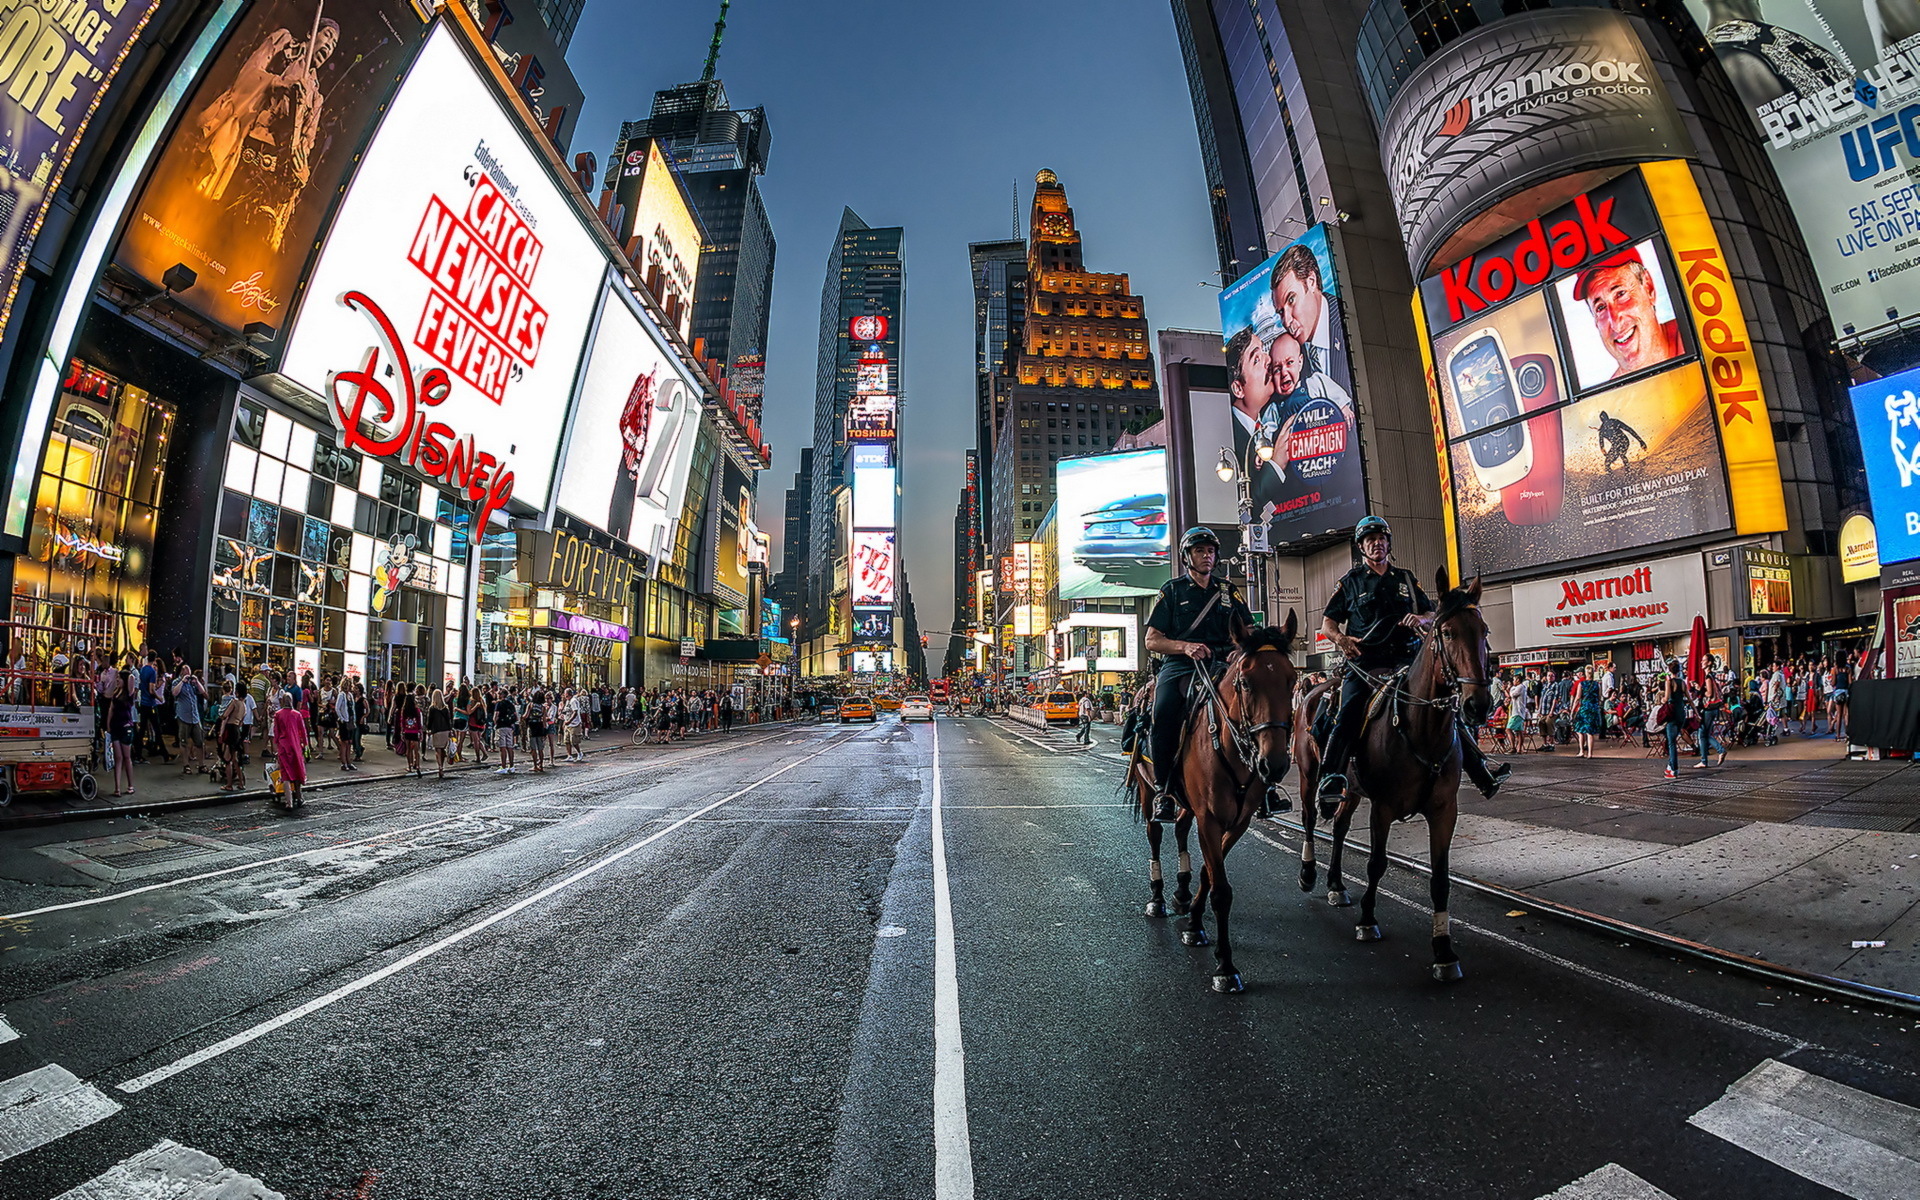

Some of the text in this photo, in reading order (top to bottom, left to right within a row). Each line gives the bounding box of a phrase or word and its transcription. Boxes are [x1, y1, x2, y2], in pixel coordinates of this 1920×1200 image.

[1814, 13, 1835, 40] LIGHT
[1832, 40, 1857, 75] WORLD
[1506, 83, 1652, 118] driving emotion
[1756, 91, 1797, 117] JON JONES
[1856, 85, 1876, 102] VS
[1760, 79, 1863, 150] BONES
[1845, 113, 1868, 128] CHAMPION
[474, 138, 519, 198] Entertainment
[624, 167, 641, 177] LG
[1849, 200, 1884, 229] SAT.
[142, 212, 227, 275] www.georgekalinsky.com
[1836, 227, 1877, 257] LIVE
[1877, 217, 1903, 242] ON
[654, 222, 692, 294] AND ONLY
[1439, 192, 1632, 323] Kodak
[411, 200, 547, 362] NEWSIES
[1831, 278, 1861, 295] UFC.COM
[1462, 343, 1478, 356] Kodak
[1678, 248, 1758, 427] Kodak
[1303, 407, 1329, 423] WILL
[848, 429, 895, 437] TOSHIBA
[1291, 430, 1343, 459] CAMPAIGN
[1424, 364, 1450, 507] Kodak
[1302, 456, 1332, 473] ZACH
[1580, 466, 1709, 507] BUILT FOR THE WAY YOU PLAY.
[1273, 496, 1308, 515] AUGUST
[1309, 491, 1320, 504] 10
[1745, 551, 1790, 566] MARQUIS
[1846, 540, 1875, 556] Marriott
[549, 527, 634, 606] FOREVER
[967, 548, 976, 608] YOUNG
[1556, 566, 1653, 611] Marriott
[1545, 601, 1669, 629] NEW YORK MARQUIS
[671, 664, 699, 677] VORNADO
[1634, 661, 1639, 673] A
[40, 772, 54, 781] JLG
